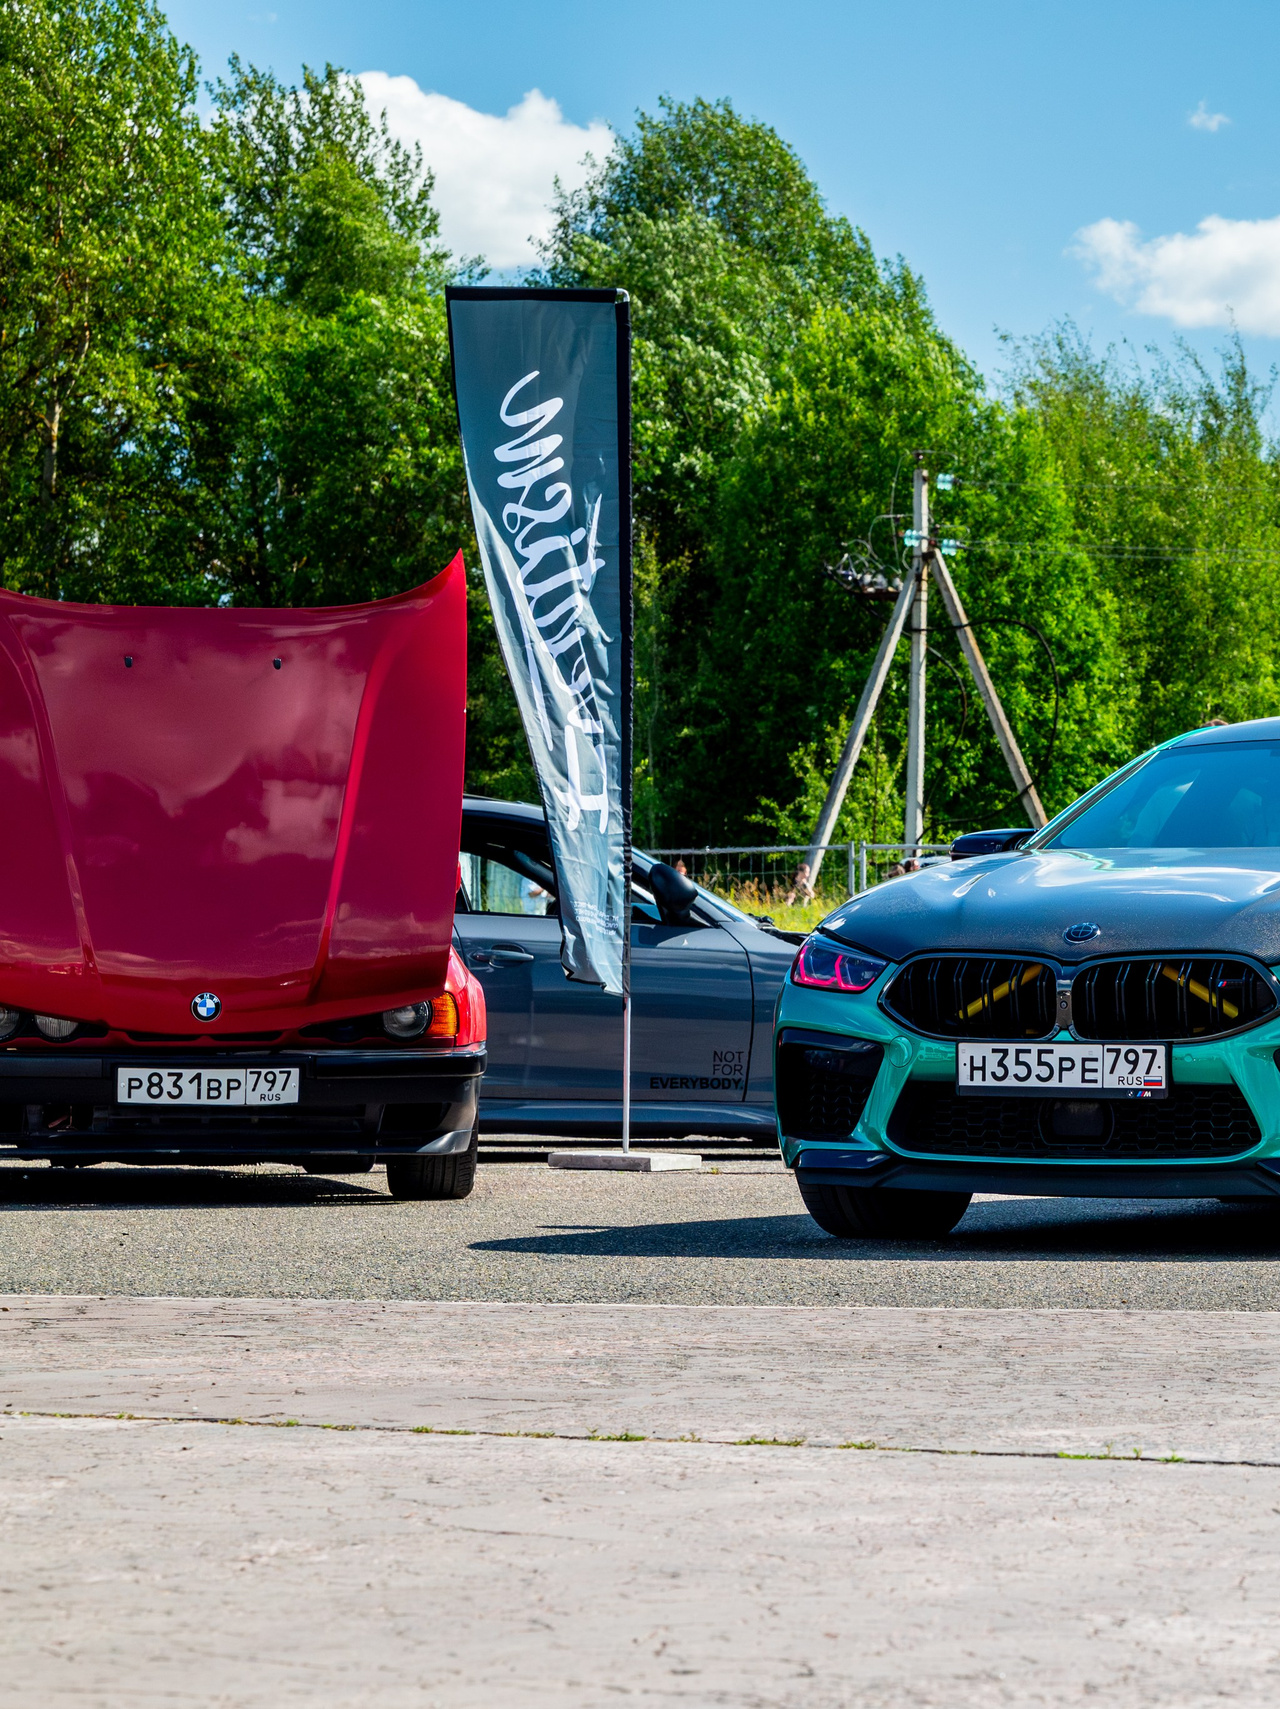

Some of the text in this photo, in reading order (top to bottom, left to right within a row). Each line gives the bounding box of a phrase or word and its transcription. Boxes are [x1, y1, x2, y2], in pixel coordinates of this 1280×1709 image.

[713, 1050, 745, 1064] NOT
[712, 1063, 744, 1076] FOR
[969, 1047, 1158, 1084] Н355РЕ 797
[127, 1070, 292, 1101] Р831ВР 797
[649, 1076, 744, 1090] EVERYBODY.
[1117, 1075, 1143, 1086] RUS
[259, 1093, 282, 1102] RUS
